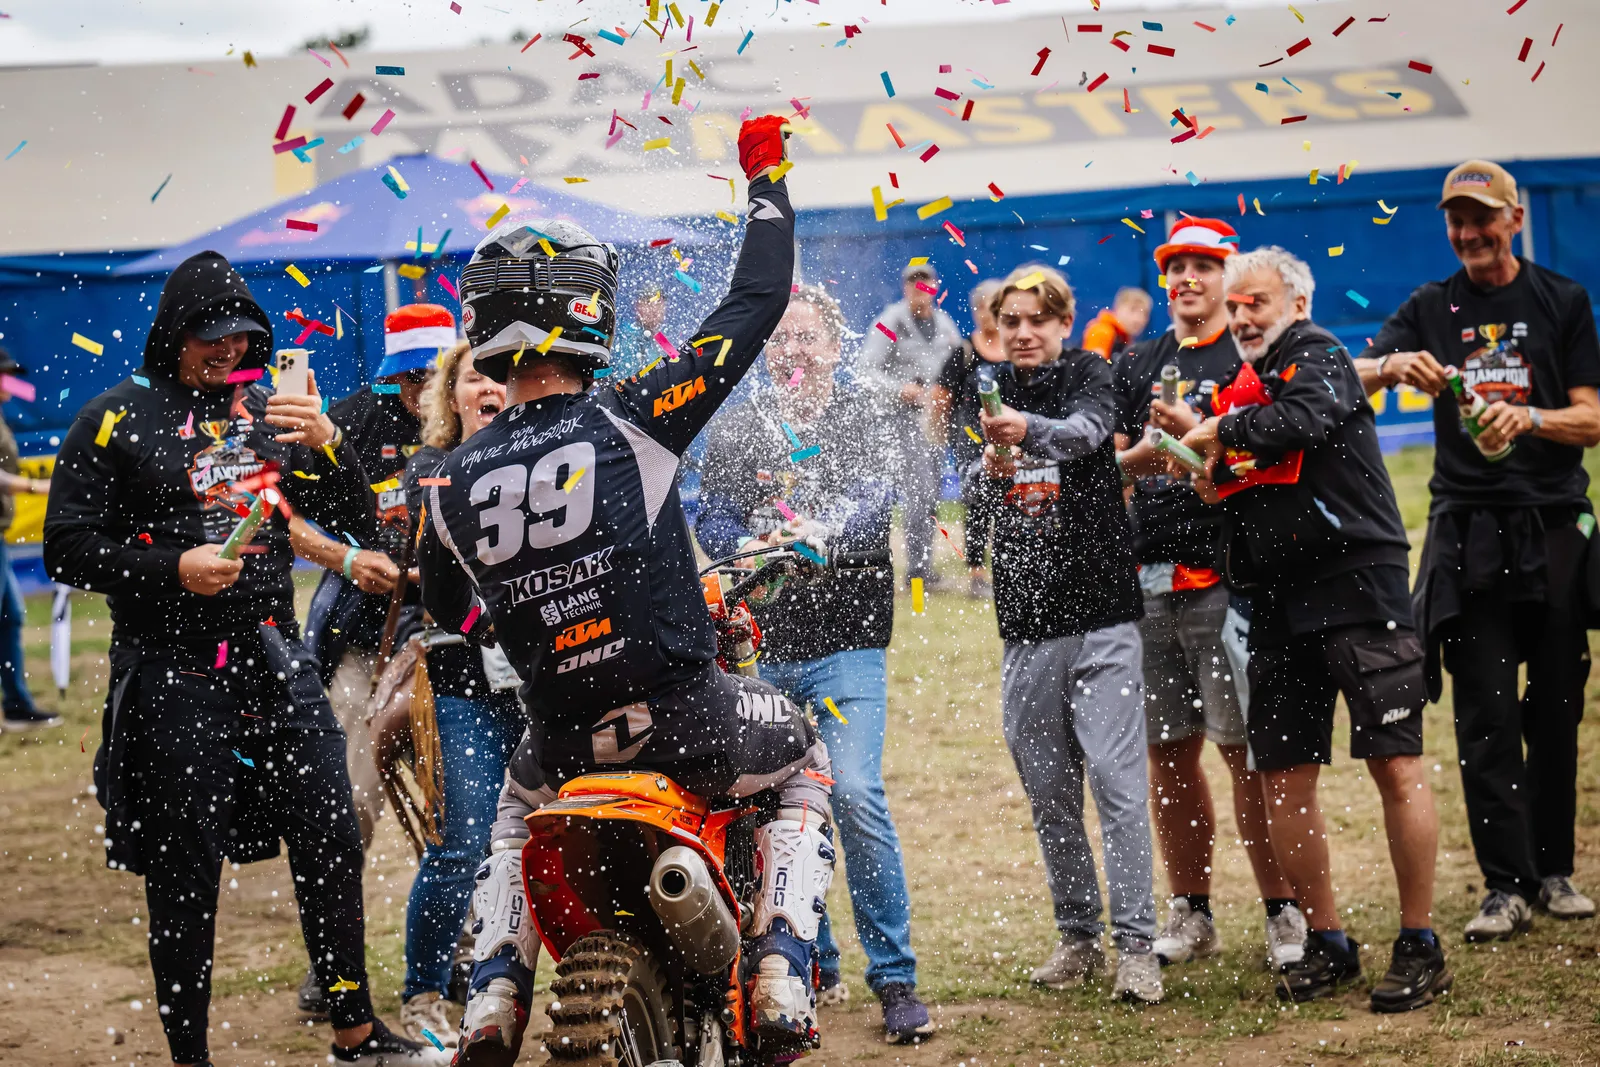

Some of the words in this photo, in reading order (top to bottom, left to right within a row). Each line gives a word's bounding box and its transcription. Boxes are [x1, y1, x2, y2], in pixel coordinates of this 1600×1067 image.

[690, 68, 1434, 161] MASTERS
[1463, 367, 1529, 388] HAMPION
[653, 376, 706, 417] KTM
[510, 423, 538, 440] ROAN
[461, 447, 484, 468] VAN
[484, 443, 508, 461] DE
[1014, 466, 1061, 485] AMPIO
[469, 442, 596, 566] 39
[501, 545, 615, 604] KOSAK
[564, 600, 603, 620] TECHNIK
[556, 618, 612, 652] KTM
[1382, 707, 1411, 724] KTM
